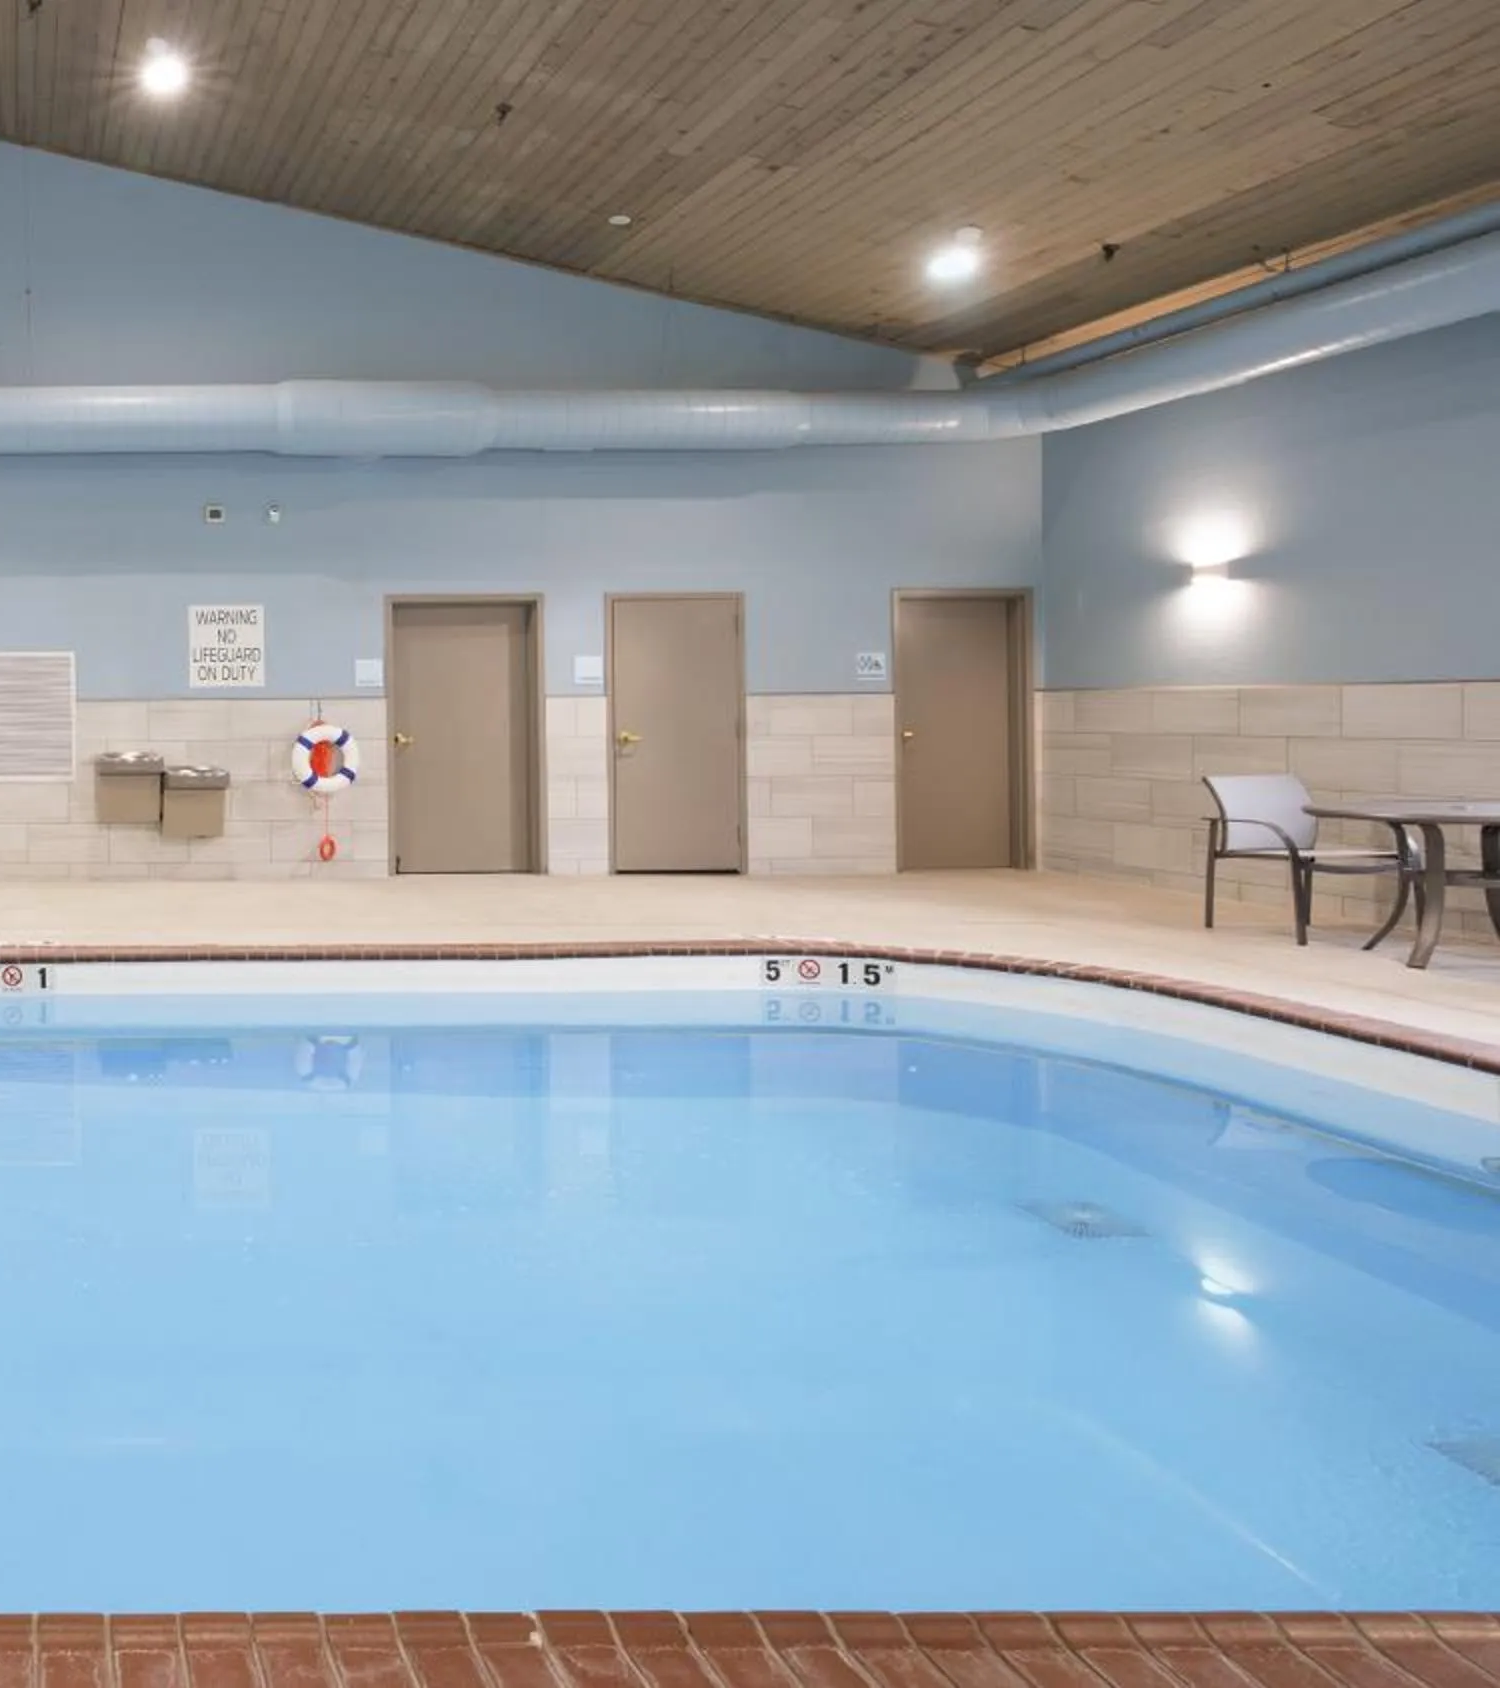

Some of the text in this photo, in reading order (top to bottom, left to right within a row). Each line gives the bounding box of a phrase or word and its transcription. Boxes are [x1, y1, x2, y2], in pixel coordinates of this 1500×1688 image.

[195, 609, 257, 625] WARNING
[217, 628, 237, 643] NO
[193, 647, 261, 662] LIFEGUARD
[197, 665, 257, 681] ON DUTY
[766, 960, 781, 981] 5
